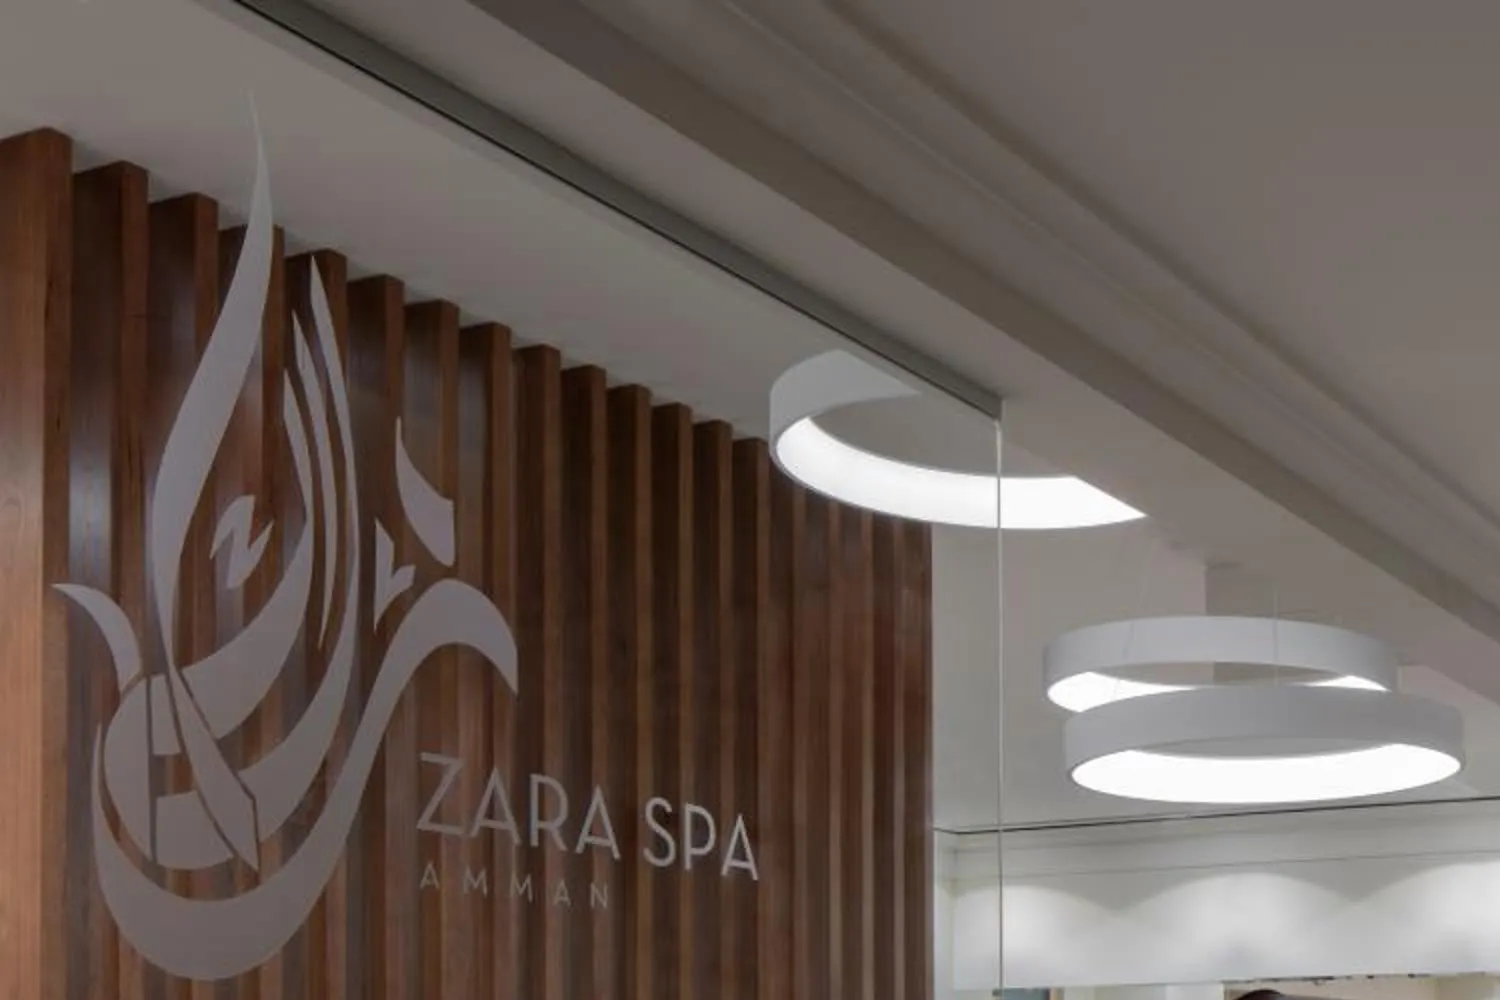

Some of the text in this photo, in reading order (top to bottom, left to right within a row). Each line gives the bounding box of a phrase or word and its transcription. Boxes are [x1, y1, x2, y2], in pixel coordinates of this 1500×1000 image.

[416, 751, 760, 881] ZARA SPA
[419, 861, 609, 909] AMMAN
